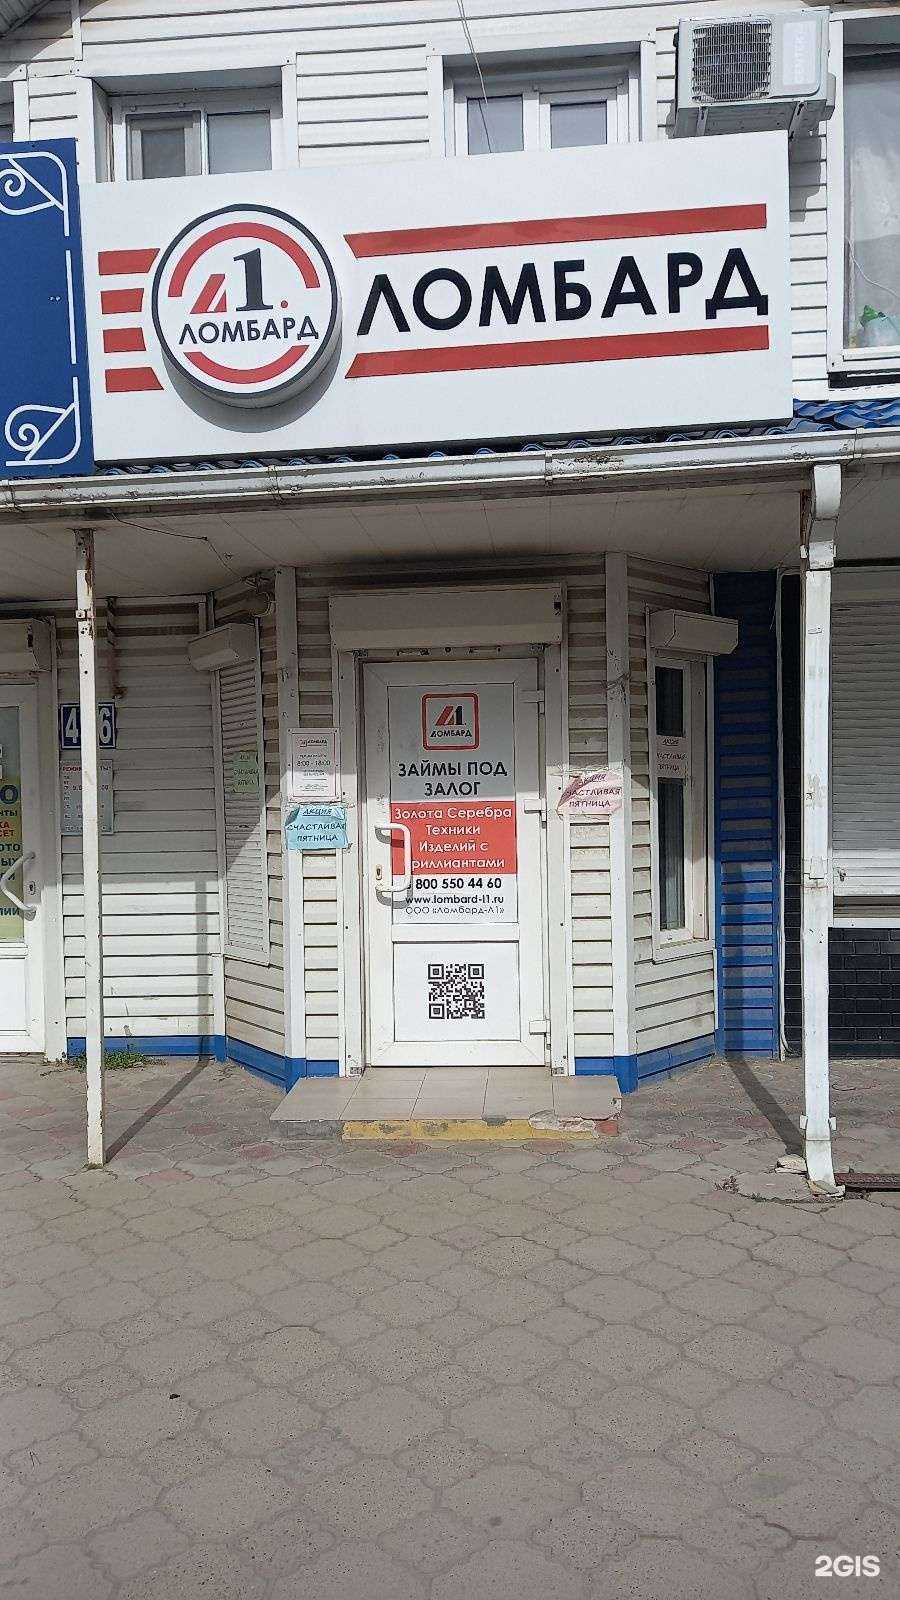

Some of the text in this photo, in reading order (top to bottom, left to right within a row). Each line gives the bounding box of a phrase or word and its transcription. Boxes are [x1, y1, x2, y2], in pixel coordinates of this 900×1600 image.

[357, 247, 768, 335] ЛОМБАРД
[179, 316, 319, 344] ЛОМБАРД
[398, 760, 508, 777] ЗАЙМЫ ПОД
[424, 781, 481, 797] ЗАЛОГ
[394, 806, 512, 820] Золота Серебра
[426, 825, 480, 836] Техники
[297, 834, 339, 842] ПЯТНИЦА
[419, 840, 475, 853] Изделий
[406, 859, 505, 871] риллиантами
[415, 879, 437, 889] 800
[441, 879, 464, 889] 550
[467, 878, 483, 888] 44
[486, 878, 502, 888] 60
[405, 906, 430, 914] ООО
